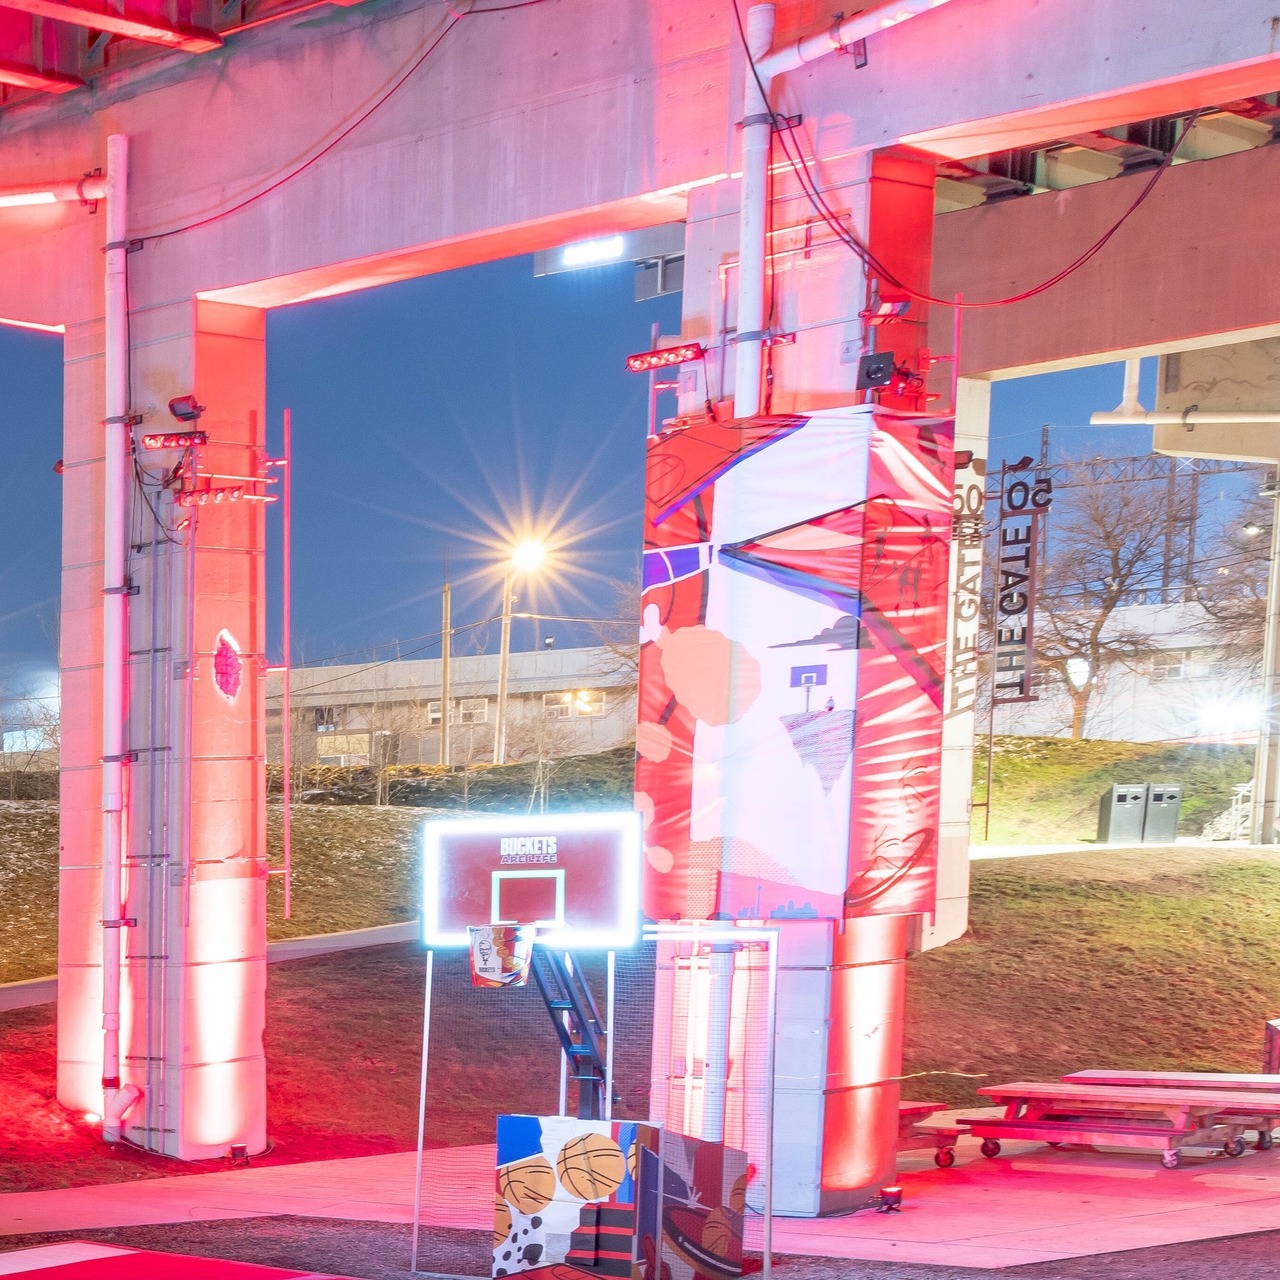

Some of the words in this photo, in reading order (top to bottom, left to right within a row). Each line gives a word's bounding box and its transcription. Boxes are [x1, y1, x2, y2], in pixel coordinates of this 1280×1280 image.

[500, 836, 557, 855] BUCKETS
[500, 855, 526, 864] ARE
[527, 854, 557, 863] LIFE
